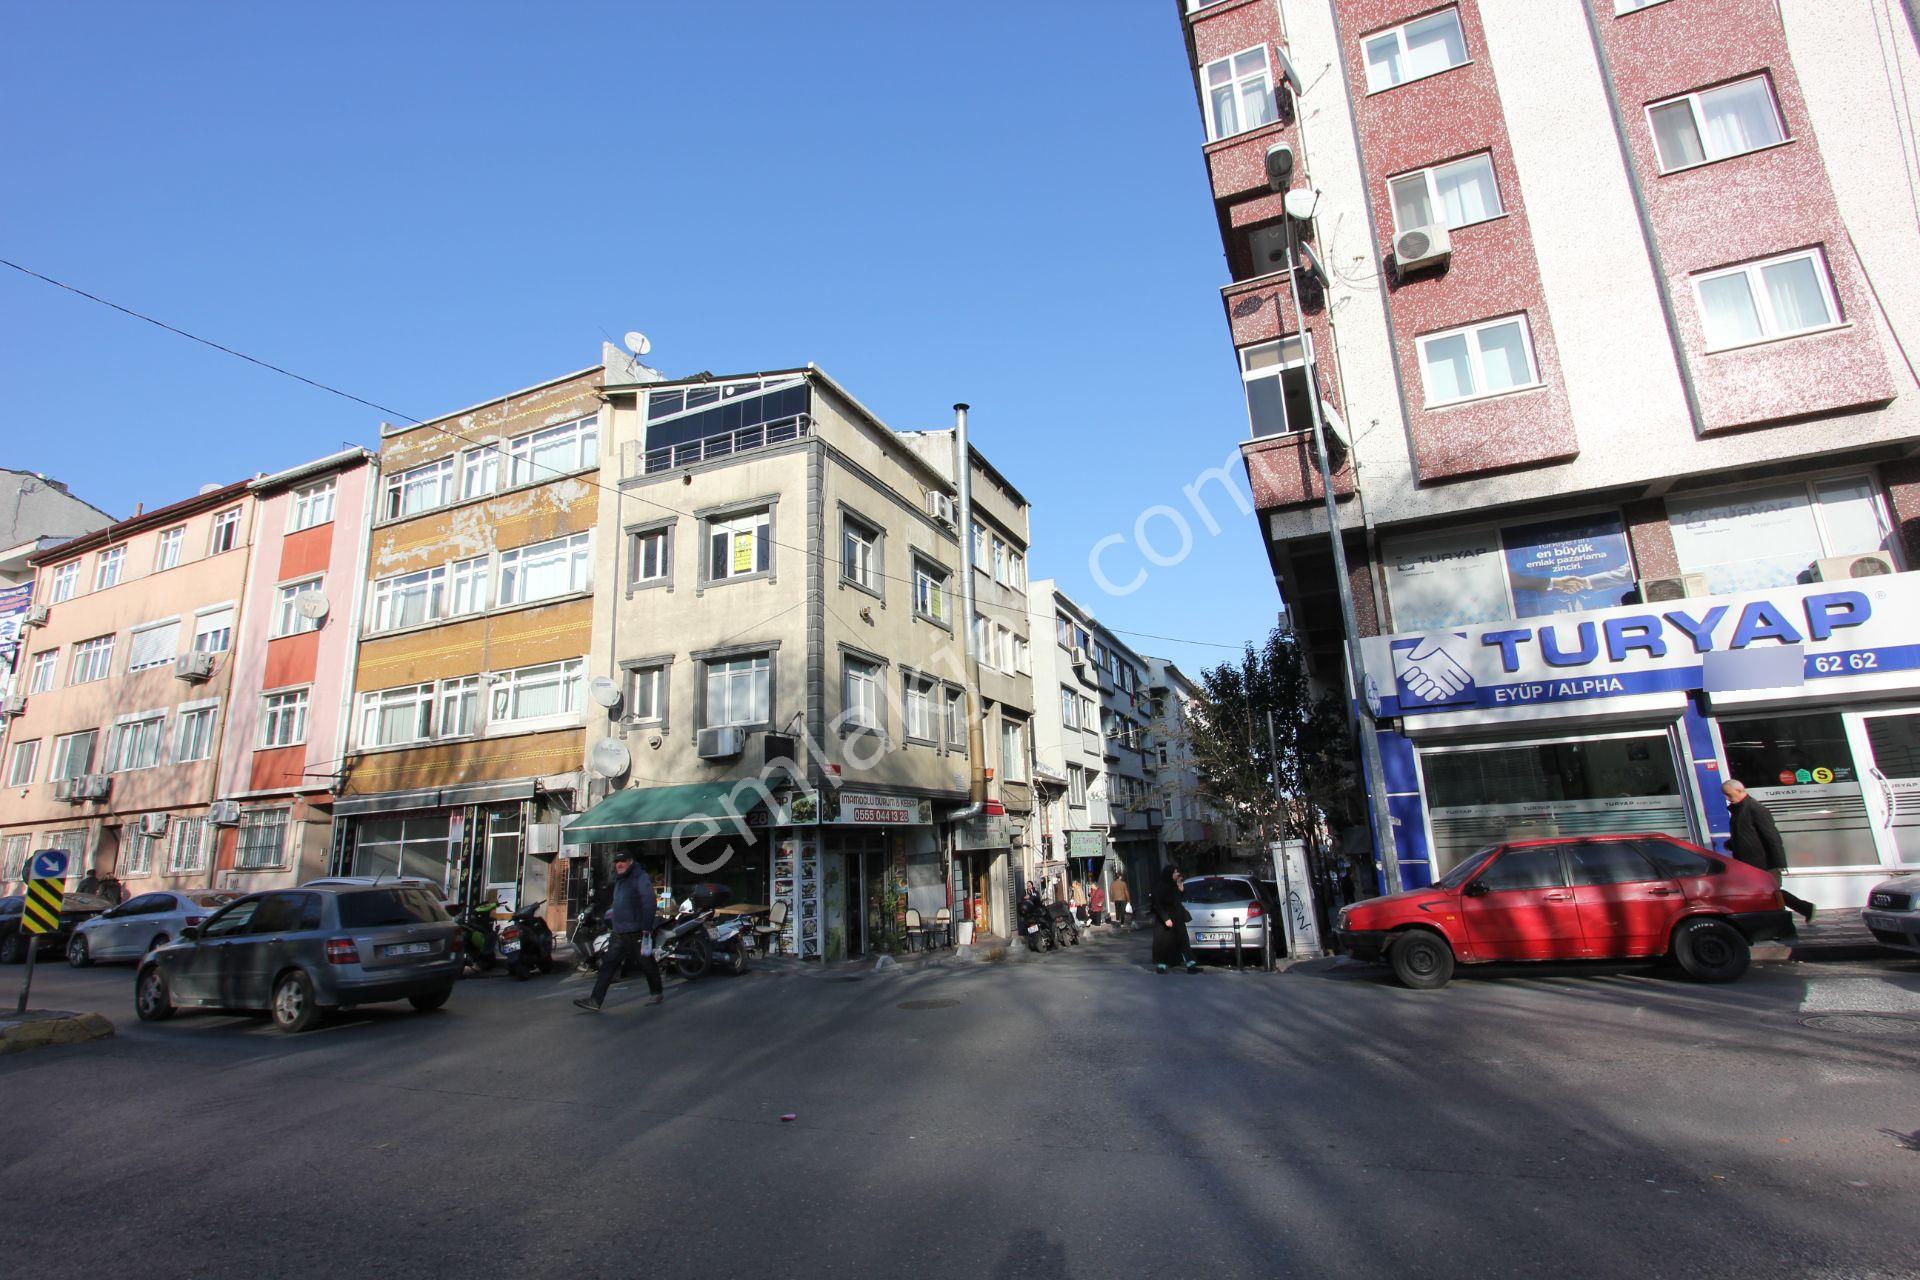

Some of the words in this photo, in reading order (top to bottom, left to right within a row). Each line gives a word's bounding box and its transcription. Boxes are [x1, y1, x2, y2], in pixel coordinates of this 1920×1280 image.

[1418, 547, 1487, 565] TURYAP
[1526, 558, 1555, 568] emlak
[1556, 551, 1608, 565] pazarlama
[1536, 550, 1552, 559] en
[1554, 543, 1594, 557] büyük
[1481, 590, 1873, 673] TURYAP
[1815, 655, 1843, 673] 62
[1849, 652, 1878, 670] 62
[1495, 684, 1543, 702] EYÜP
[1558, 677, 1624, 696] ALPHA
[1765, 789, 1797, 797] TURYAP
[854, 809, 875, 821] 0555
